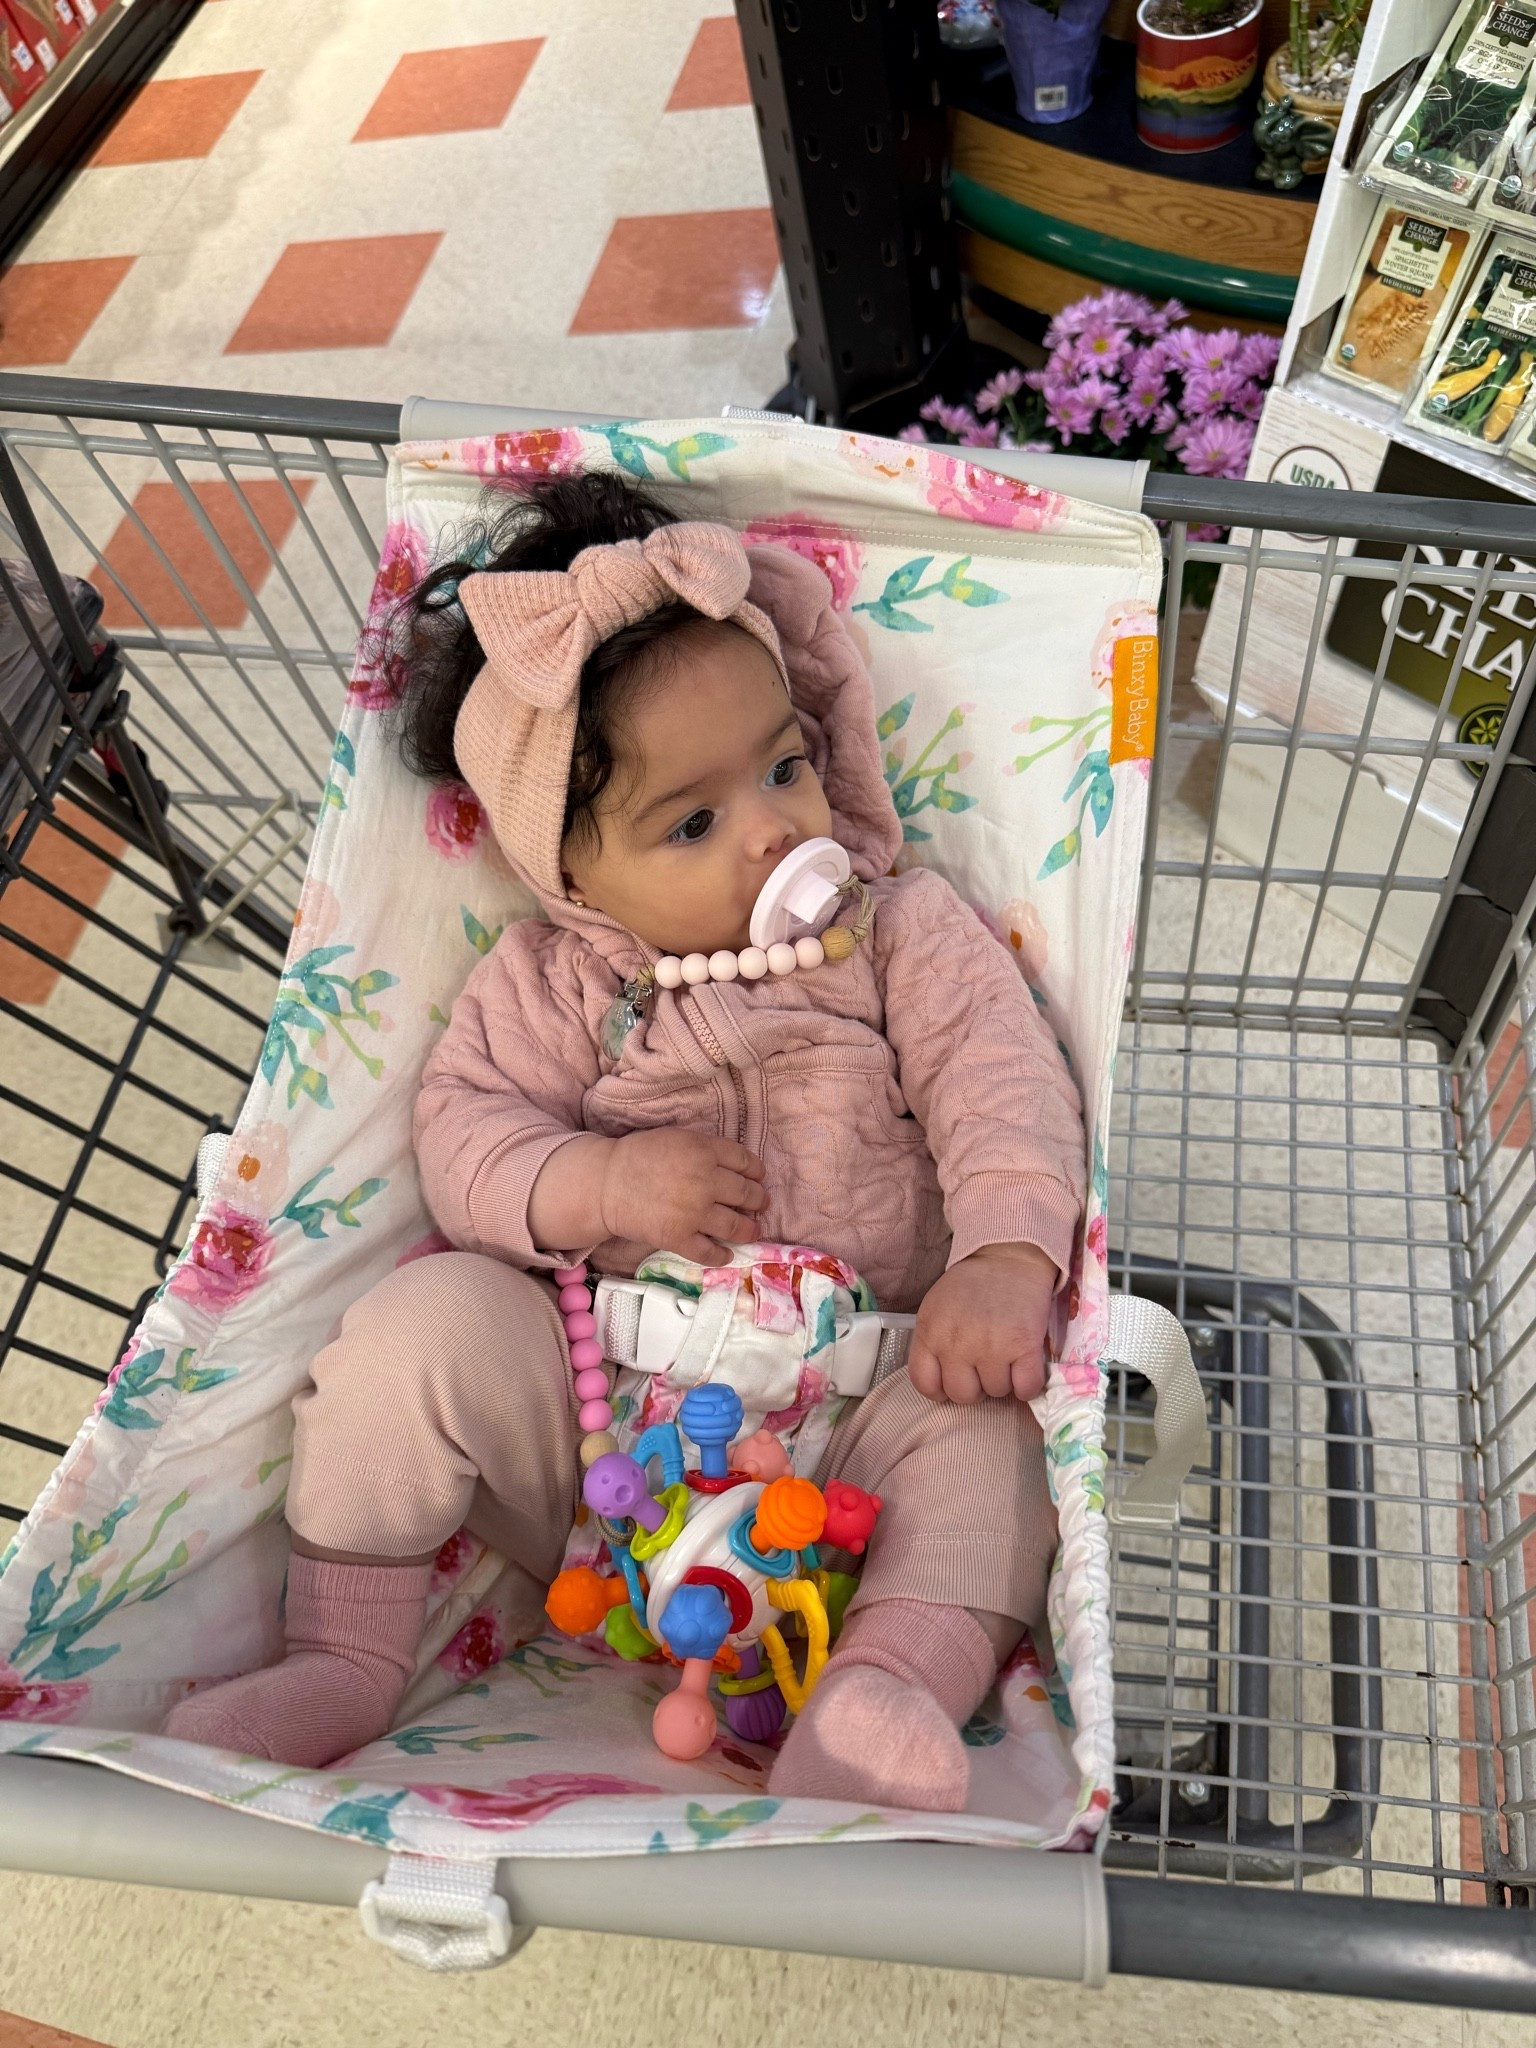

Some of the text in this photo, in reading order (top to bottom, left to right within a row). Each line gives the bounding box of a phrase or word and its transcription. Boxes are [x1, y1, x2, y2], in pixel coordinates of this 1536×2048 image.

[1496, 12, 1528, 28] SEEDS
[1492, 20, 1528, 40] CHANGE
[1407, 221, 1435, 236] SEEDS
[1404, 229, 1439, 246] CHANGE
